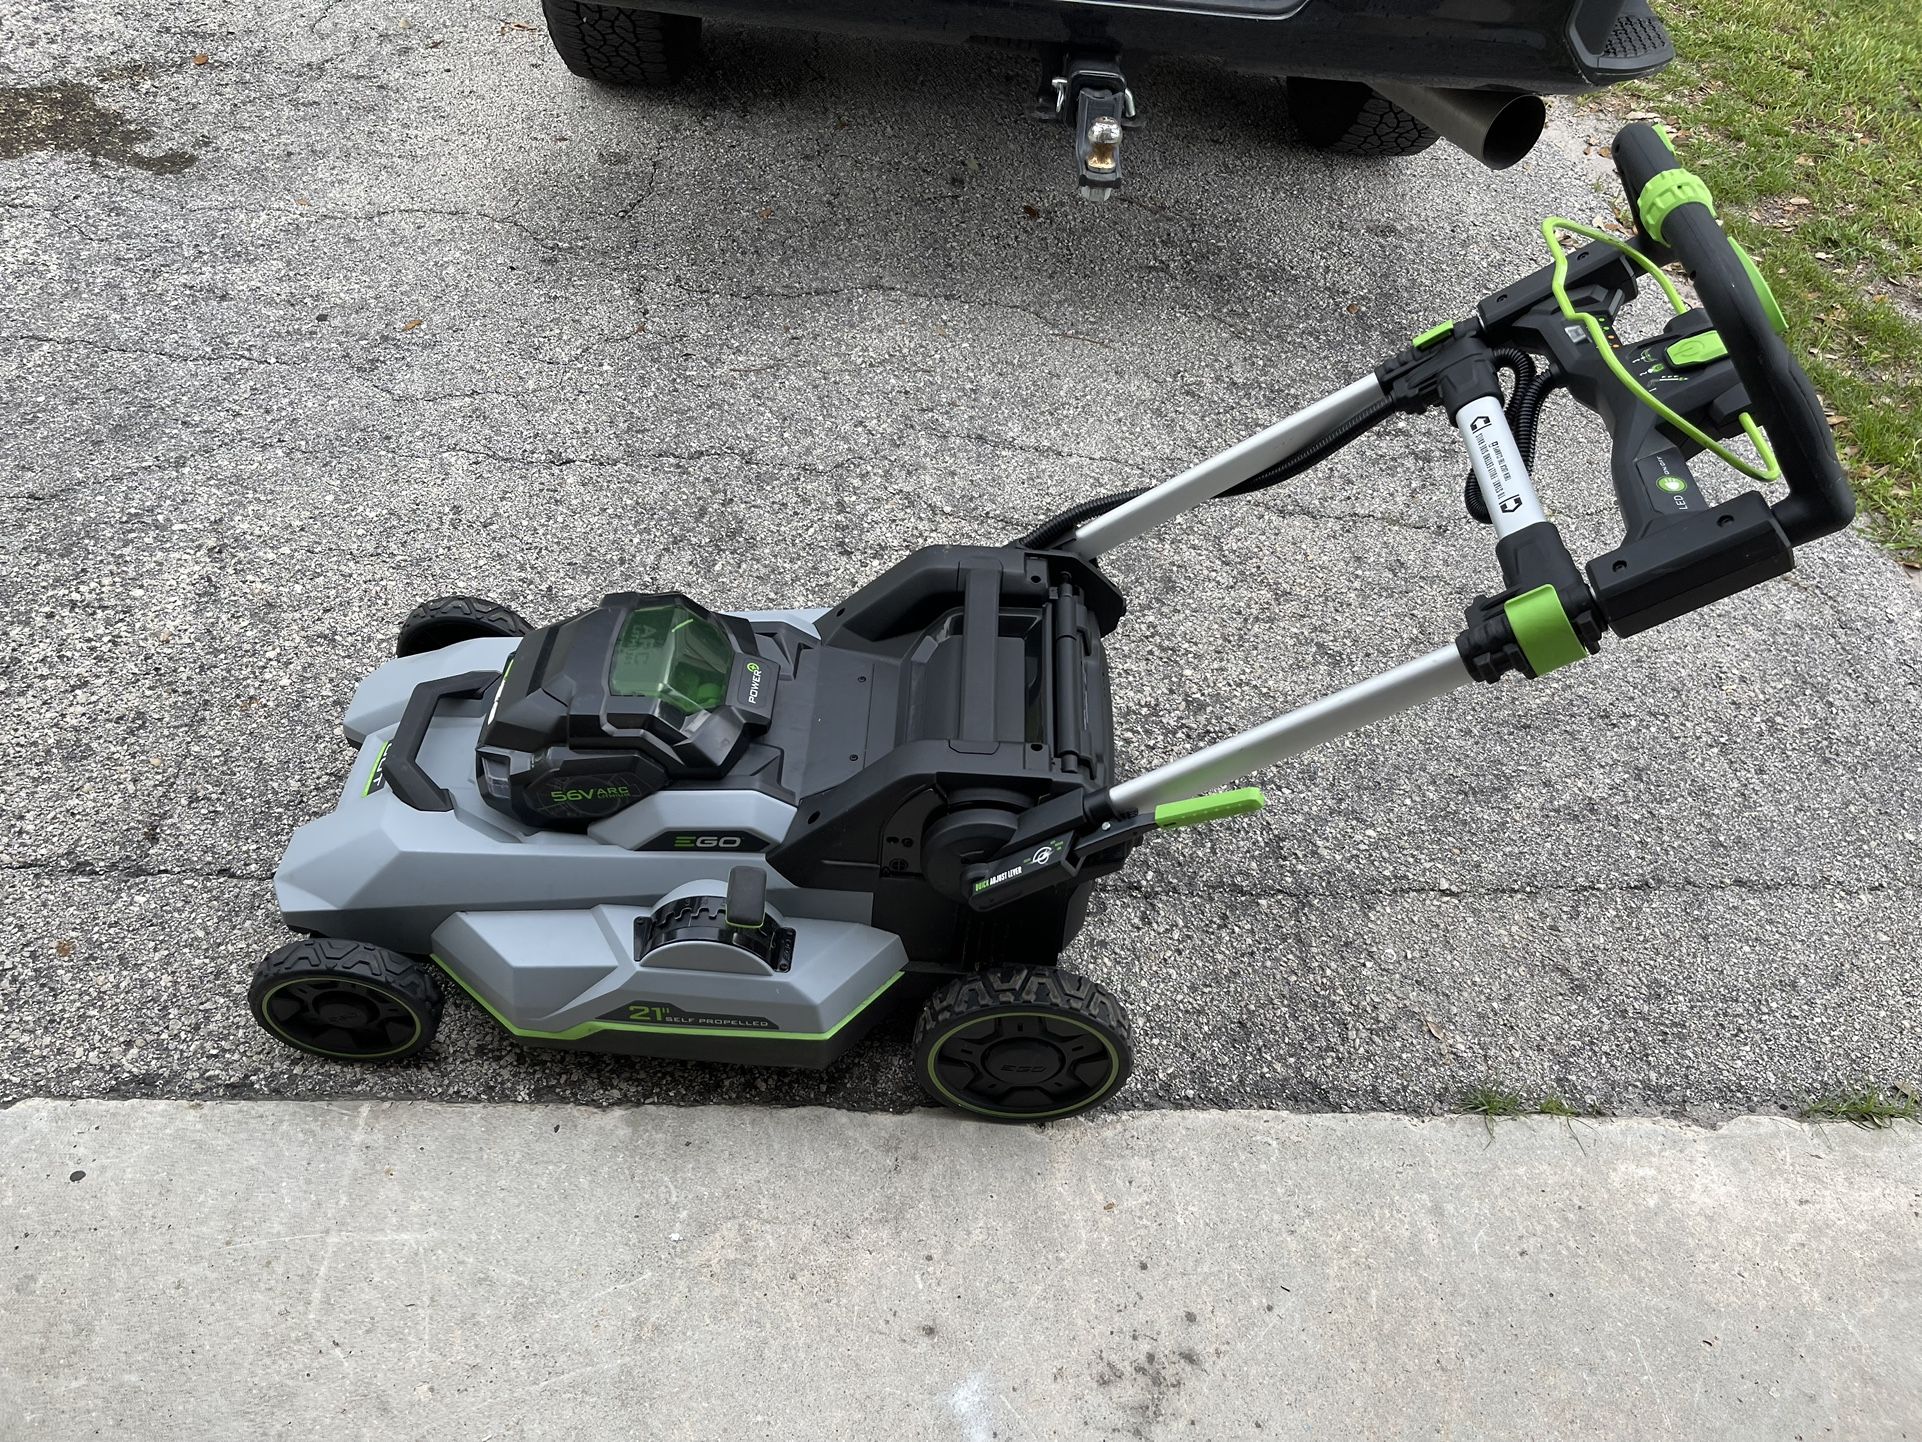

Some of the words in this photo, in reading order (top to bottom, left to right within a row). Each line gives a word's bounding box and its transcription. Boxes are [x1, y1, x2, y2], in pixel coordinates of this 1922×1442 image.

[1483, 453, 1494, 468] EXTEND
[1673, 495, 1688, 510] LED
[550, 788, 594, 802] 56V
[597, 786, 629, 795] ARC
[674, 836, 741, 848] EGO
[975, 879, 990, 892] QUICK
[990, 871, 1007, 886] ADJUST
[1007, 865, 1022, 879] LEVER
[628, 1005, 670, 1021] 21"
[665, 1016, 696, 1024] SELF
[699, 1018, 769, 1027] PROPELLED
[1000, 1064, 1047, 1074] EGO
